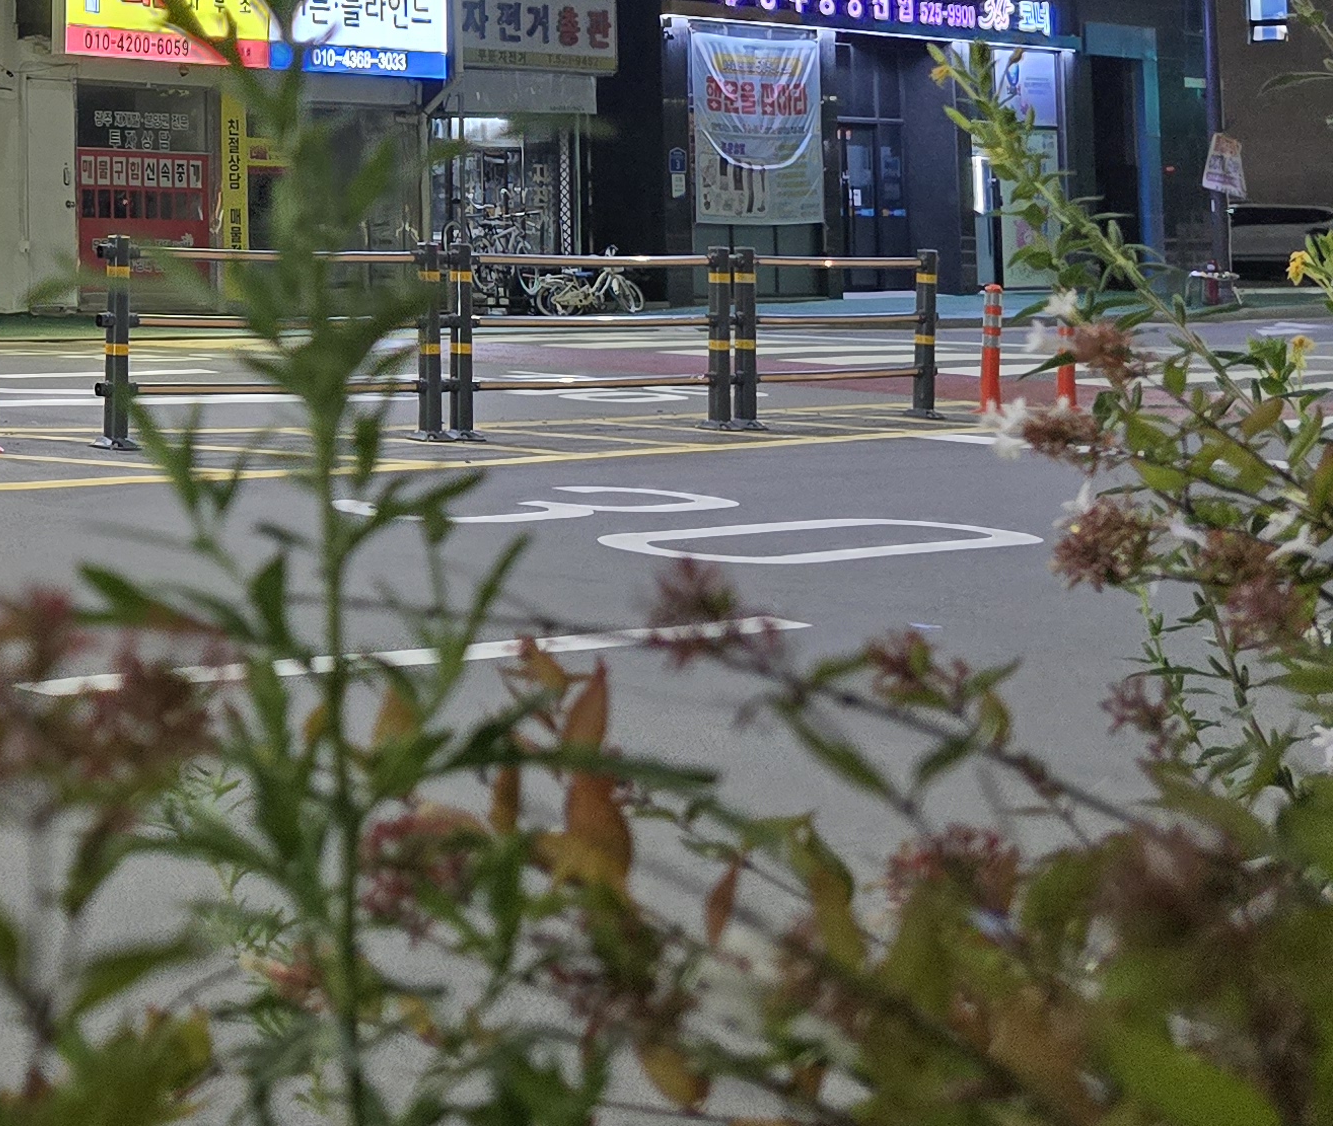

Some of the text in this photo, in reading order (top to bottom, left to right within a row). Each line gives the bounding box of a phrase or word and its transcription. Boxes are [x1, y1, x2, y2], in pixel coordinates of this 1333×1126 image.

[919, 1, 976, 29] 525-9900
[85, 33, 189, 56] 010-4200-6059
[312, 48, 407, 71] 010-4368-3033
